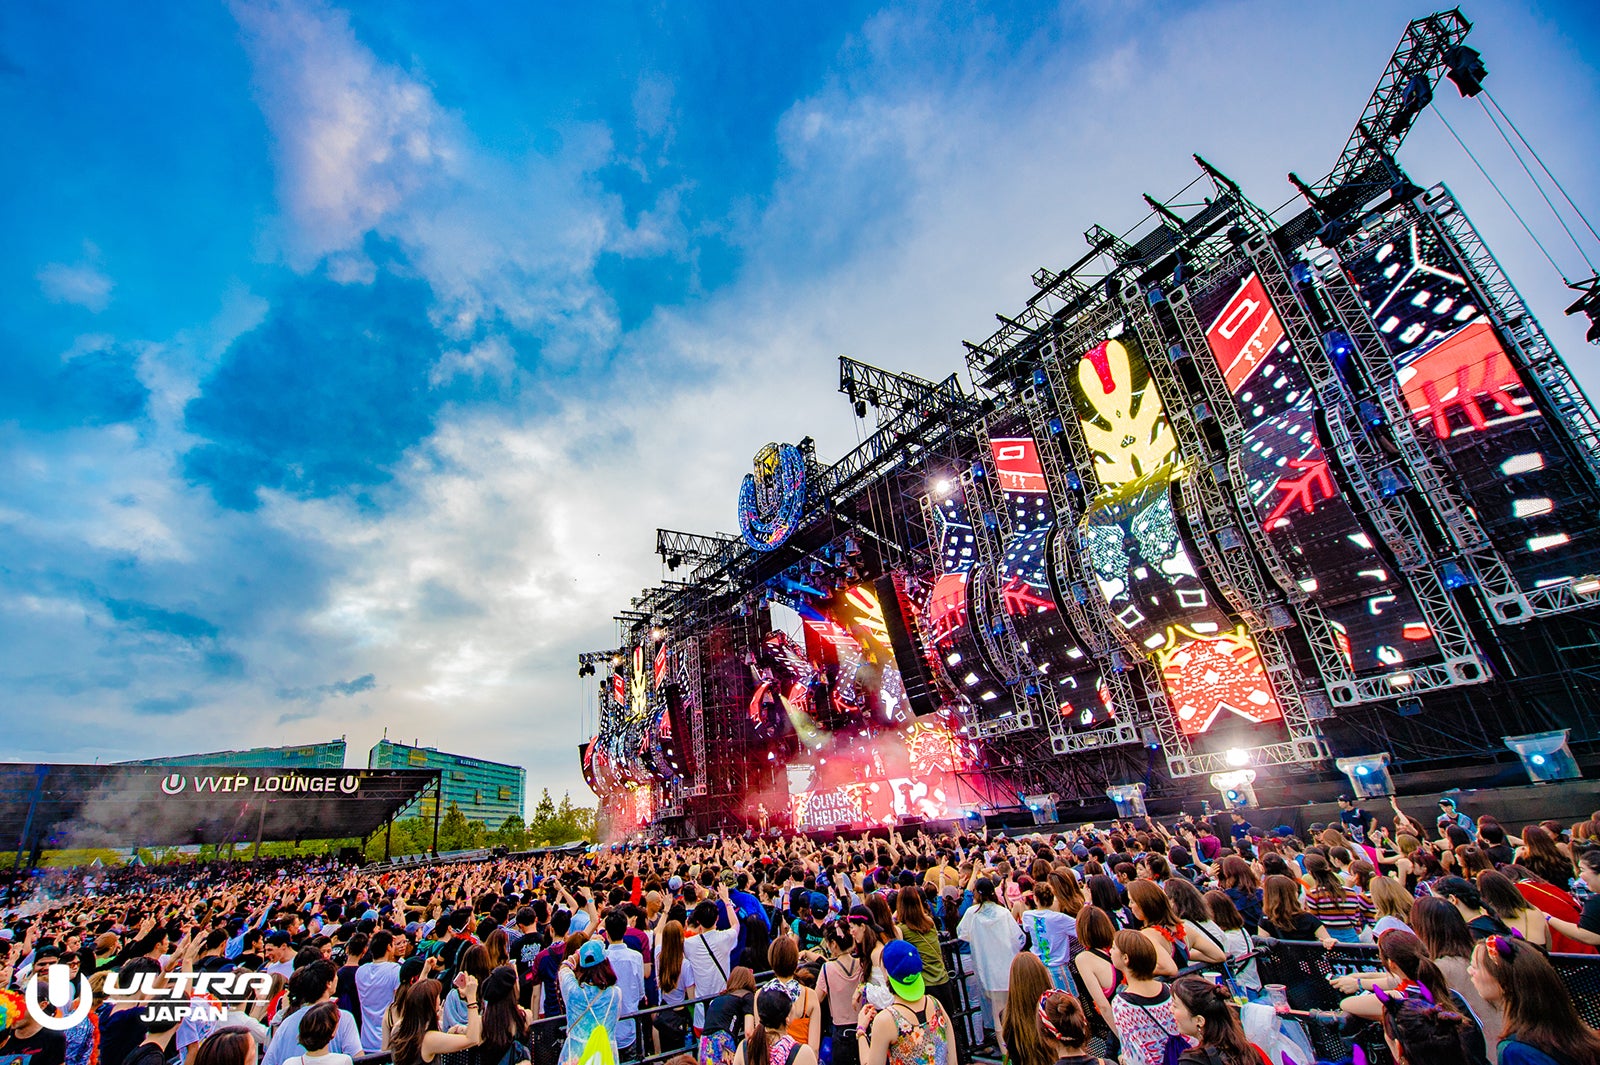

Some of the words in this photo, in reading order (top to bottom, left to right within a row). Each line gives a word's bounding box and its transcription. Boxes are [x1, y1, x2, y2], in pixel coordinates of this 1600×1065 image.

[193, 776, 249, 792] VVIP
[253, 776, 336, 792] LOUNGE
[812, 791, 850, 809] OLIVER
